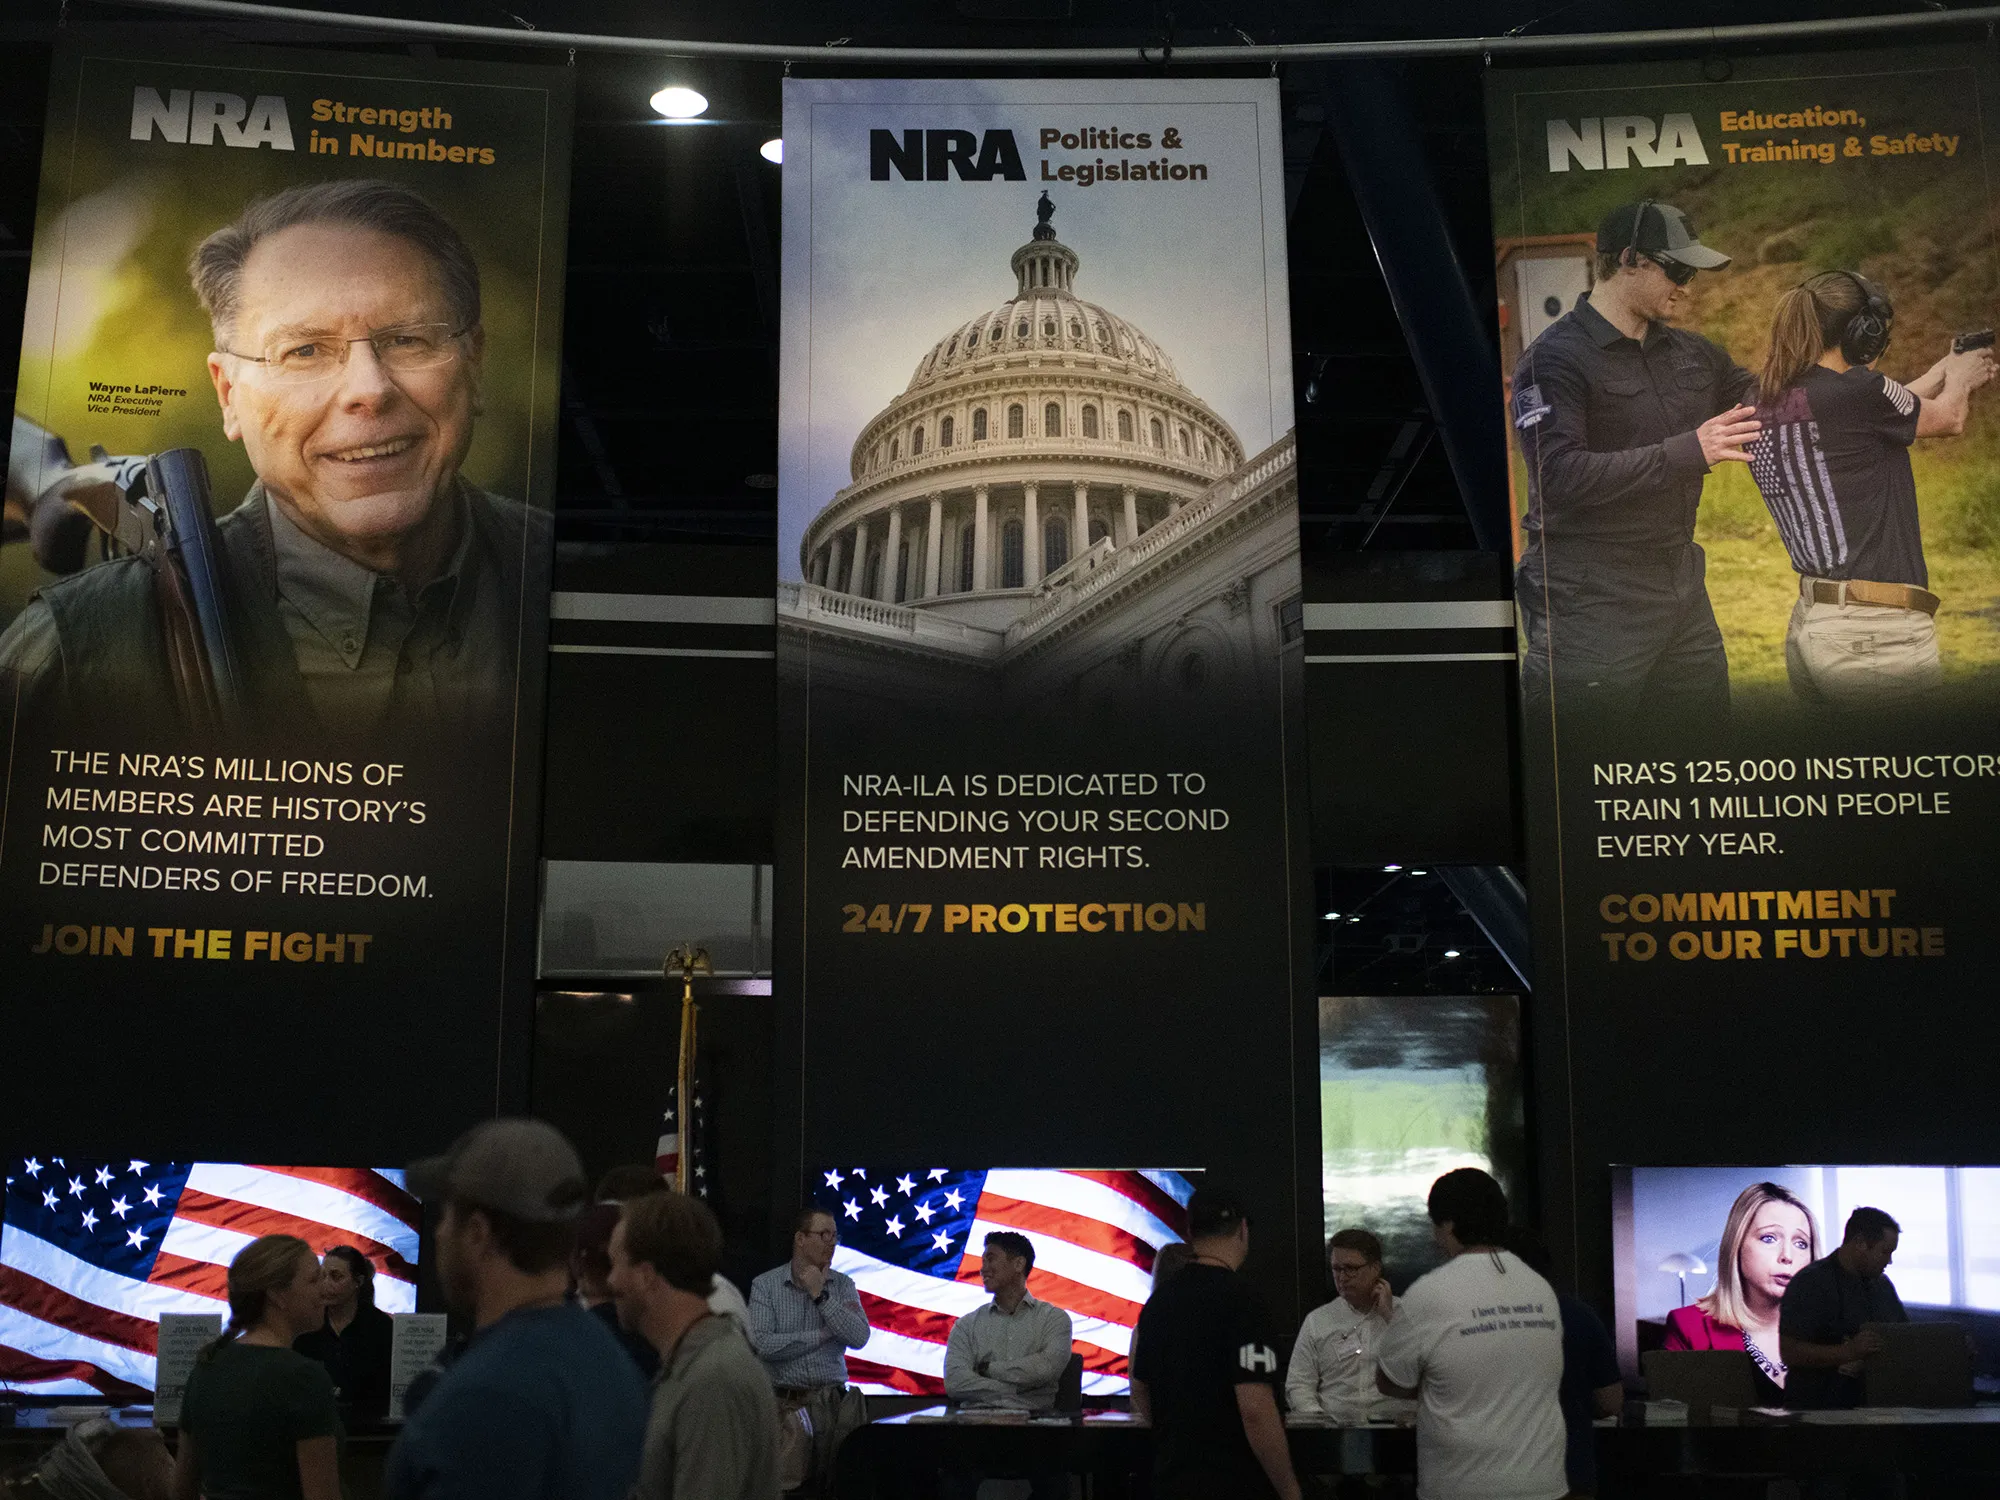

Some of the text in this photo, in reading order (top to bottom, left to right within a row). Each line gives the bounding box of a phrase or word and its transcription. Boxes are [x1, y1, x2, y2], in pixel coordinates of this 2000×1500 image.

[130, 85, 296, 151] NRA
[311, 98, 453, 132] Strength
[1720, 106, 1865, 131] Education,
[309, 129, 496, 165] in Numbers
[1040, 127, 1182, 149] Politics &
[1546, 112, 1710, 173] NRA
[1722, 133, 1958, 164] Training & Safety
[870, 129, 1026, 181] NRA
[1041, 158, 1207, 187] Legislation
[87, 393, 163, 407] NRA Executive
[89, 382, 187, 397] Wayne LaPierre
[87, 404, 161, 417] Vice President
[51, 750, 403, 785] THE NRA'S MILLIONS OF
[1594, 755, 2000, 785] NRA'S 125,000 INSTRUCTOR
[844, 773, 1205, 796] NRA-ILA IS DEDICATED TO
[47, 788, 425, 823] MEMBERS ARE HISTORY'S
[844, 809, 1229, 832] DEFENDING YOUR SECOND
[1595, 792, 1950, 821] TRAIN 1 MILLION PEOPLE
[43, 825, 324, 857] MOST COMMITTED
[1598, 832, 1783, 857] EVERY YEAR.
[842, 846, 1149, 868] AMENDMENT RIGHTS.
[40, 863, 432, 897] DEFENDERS OF FREEDOM.
[841, 902, 1206, 933] 24/7 PROTECTION
[1600, 889, 1897, 924] COMMITMENT
[32, 923, 373, 964] JOIN THE FIGHT
[1601, 927, 1947, 962] TO OUR FUTURE
[1477, 1306, 1496, 1318] love
[1497, 1305, 1511, 1315] the
